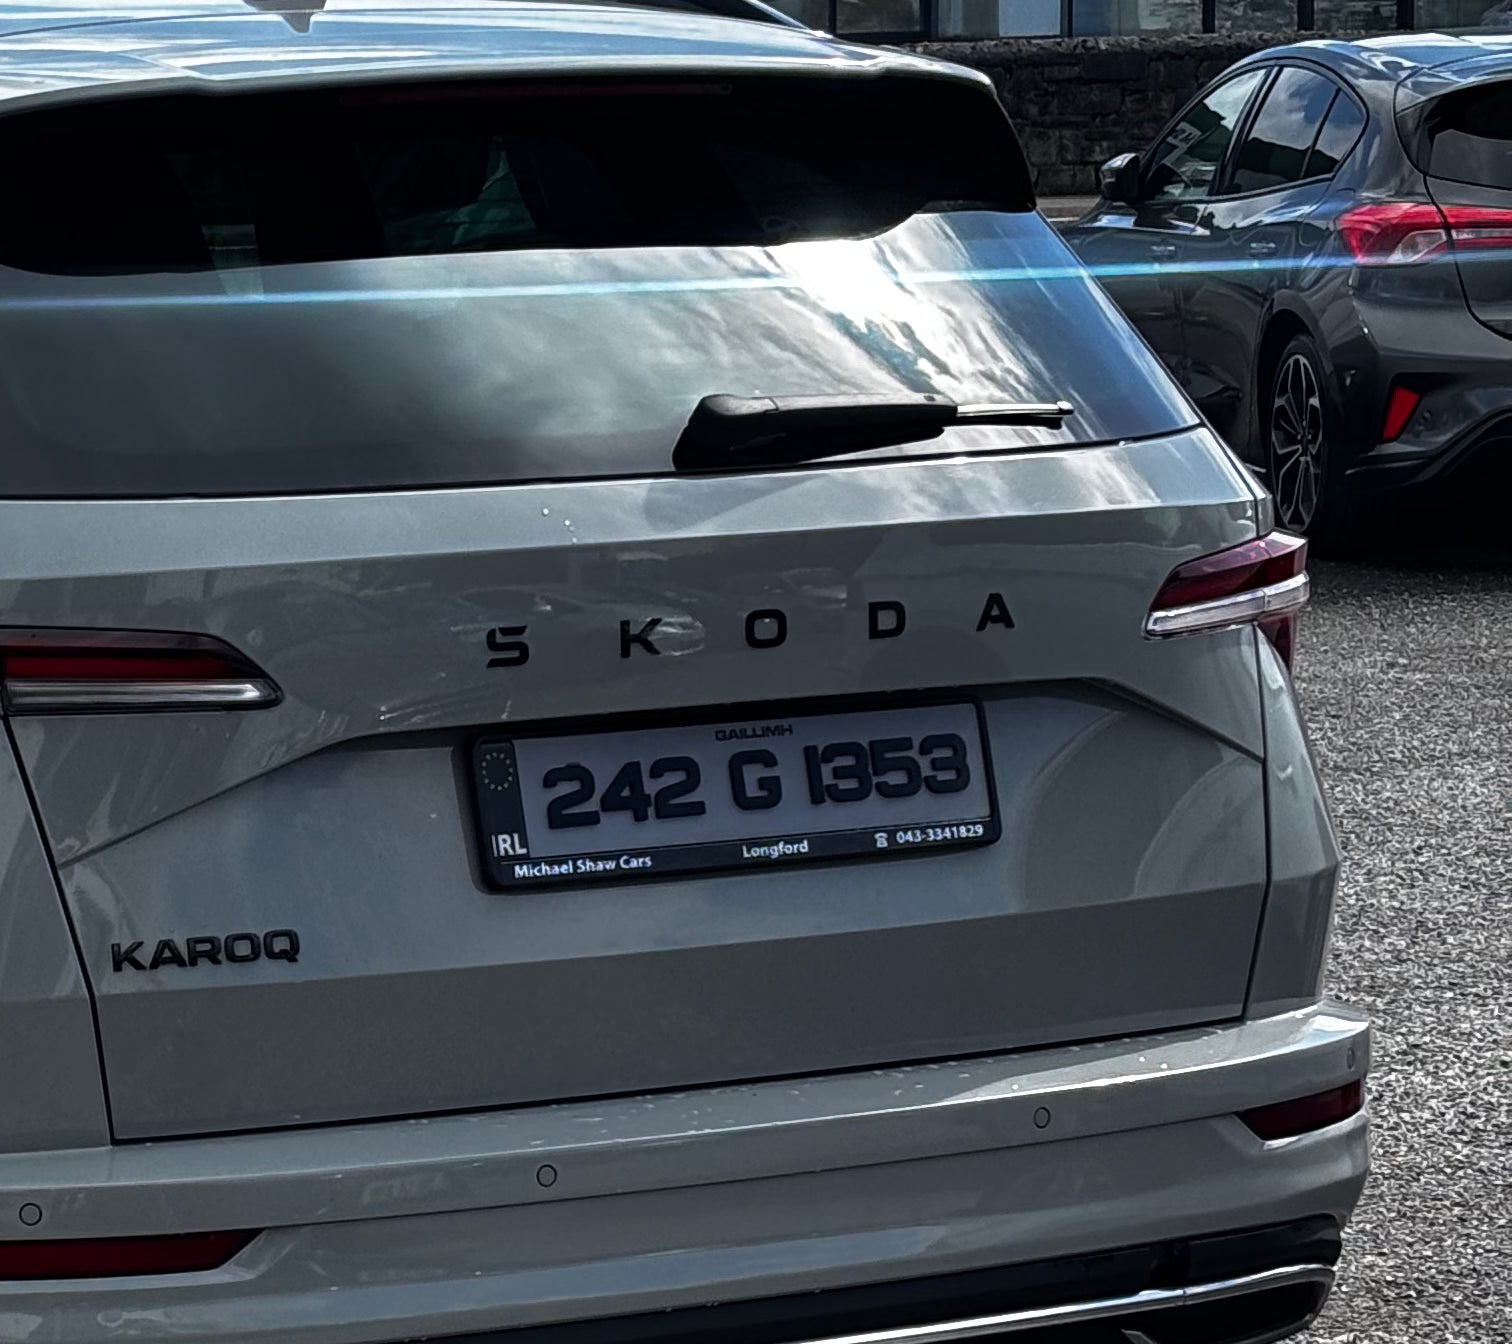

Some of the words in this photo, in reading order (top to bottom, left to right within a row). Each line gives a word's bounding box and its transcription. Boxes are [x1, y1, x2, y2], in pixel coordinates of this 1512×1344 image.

[485, 592, 1016, 669] SKODA
[714, 724, 794, 742] GAILLIMH
[542, 755, 707, 830] 242
[728, 748, 783, 811] G
[803, 732, 971, 806] 1353
[491, 833, 529, 857] IRL
[514, 859, 574, 879] Michael
[577, 857, 617, 874] Shaw
[620, 854, 652, 870] Cars
[741, 840, 809, 860] Longford
[895, 824, 984, 844] 043-3341829
[110, 928, 301, 973] KAROQ
